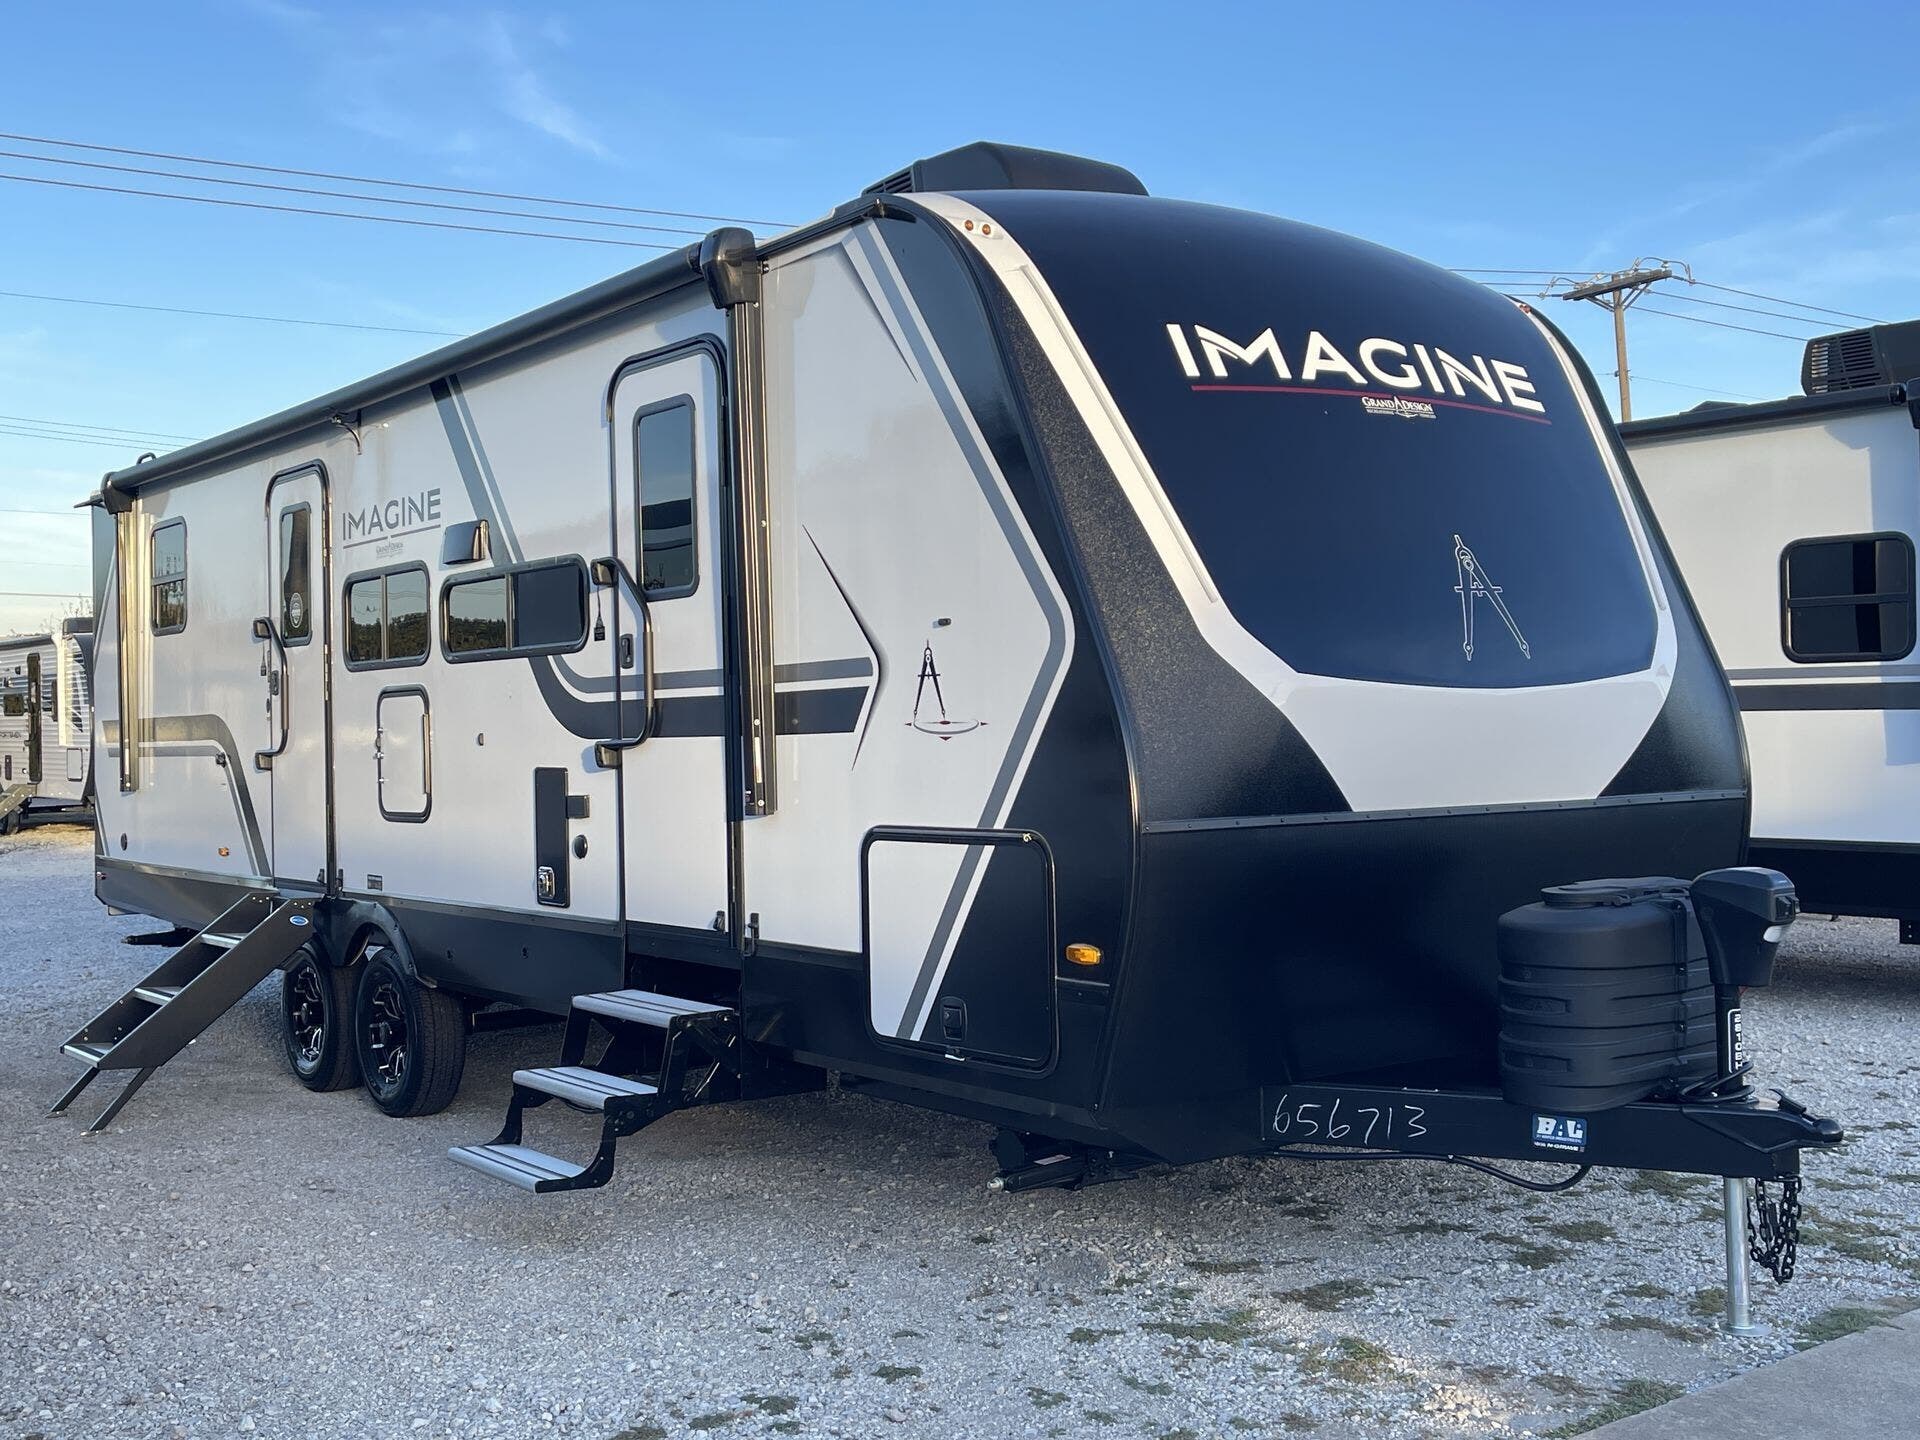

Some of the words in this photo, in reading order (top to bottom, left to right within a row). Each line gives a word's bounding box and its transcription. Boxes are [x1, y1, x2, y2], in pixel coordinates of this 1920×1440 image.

[1166, 323, 1545, 413] IMAGINE
[342, 488, 440, 540] IMAGINE
[1272, 1094, 1427, 1145] 656713
